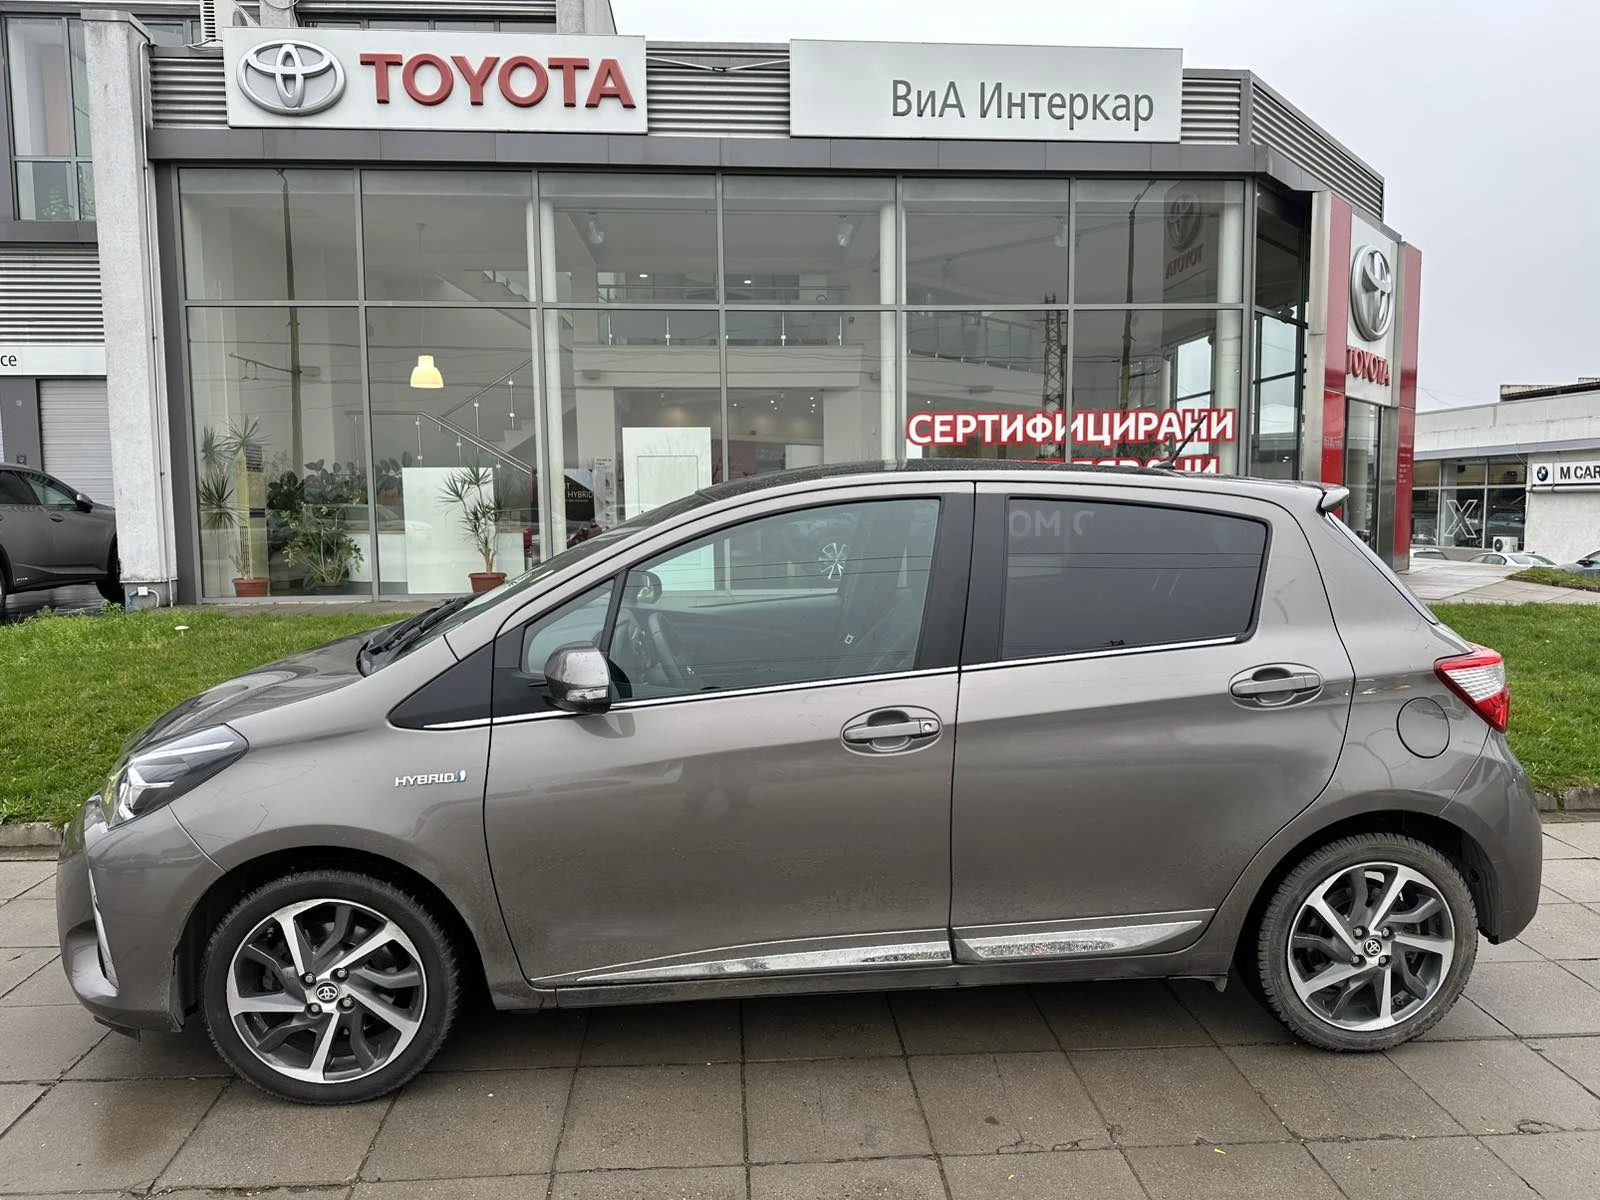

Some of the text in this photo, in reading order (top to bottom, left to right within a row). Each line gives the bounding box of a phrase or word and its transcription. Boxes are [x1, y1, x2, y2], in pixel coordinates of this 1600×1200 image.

[360, 53, 636, 109] TOYOTA
[892, 79, 1154, 132] ВиА Интеркар
[1346, 346, 1390, 387] TOYOTA
[908, 410, 1235, 447] СЕРТИФИЦИРАНИ
[1560, 465, 1600, 480] M CAR
[394, 772, 456, 787] HYBRID
